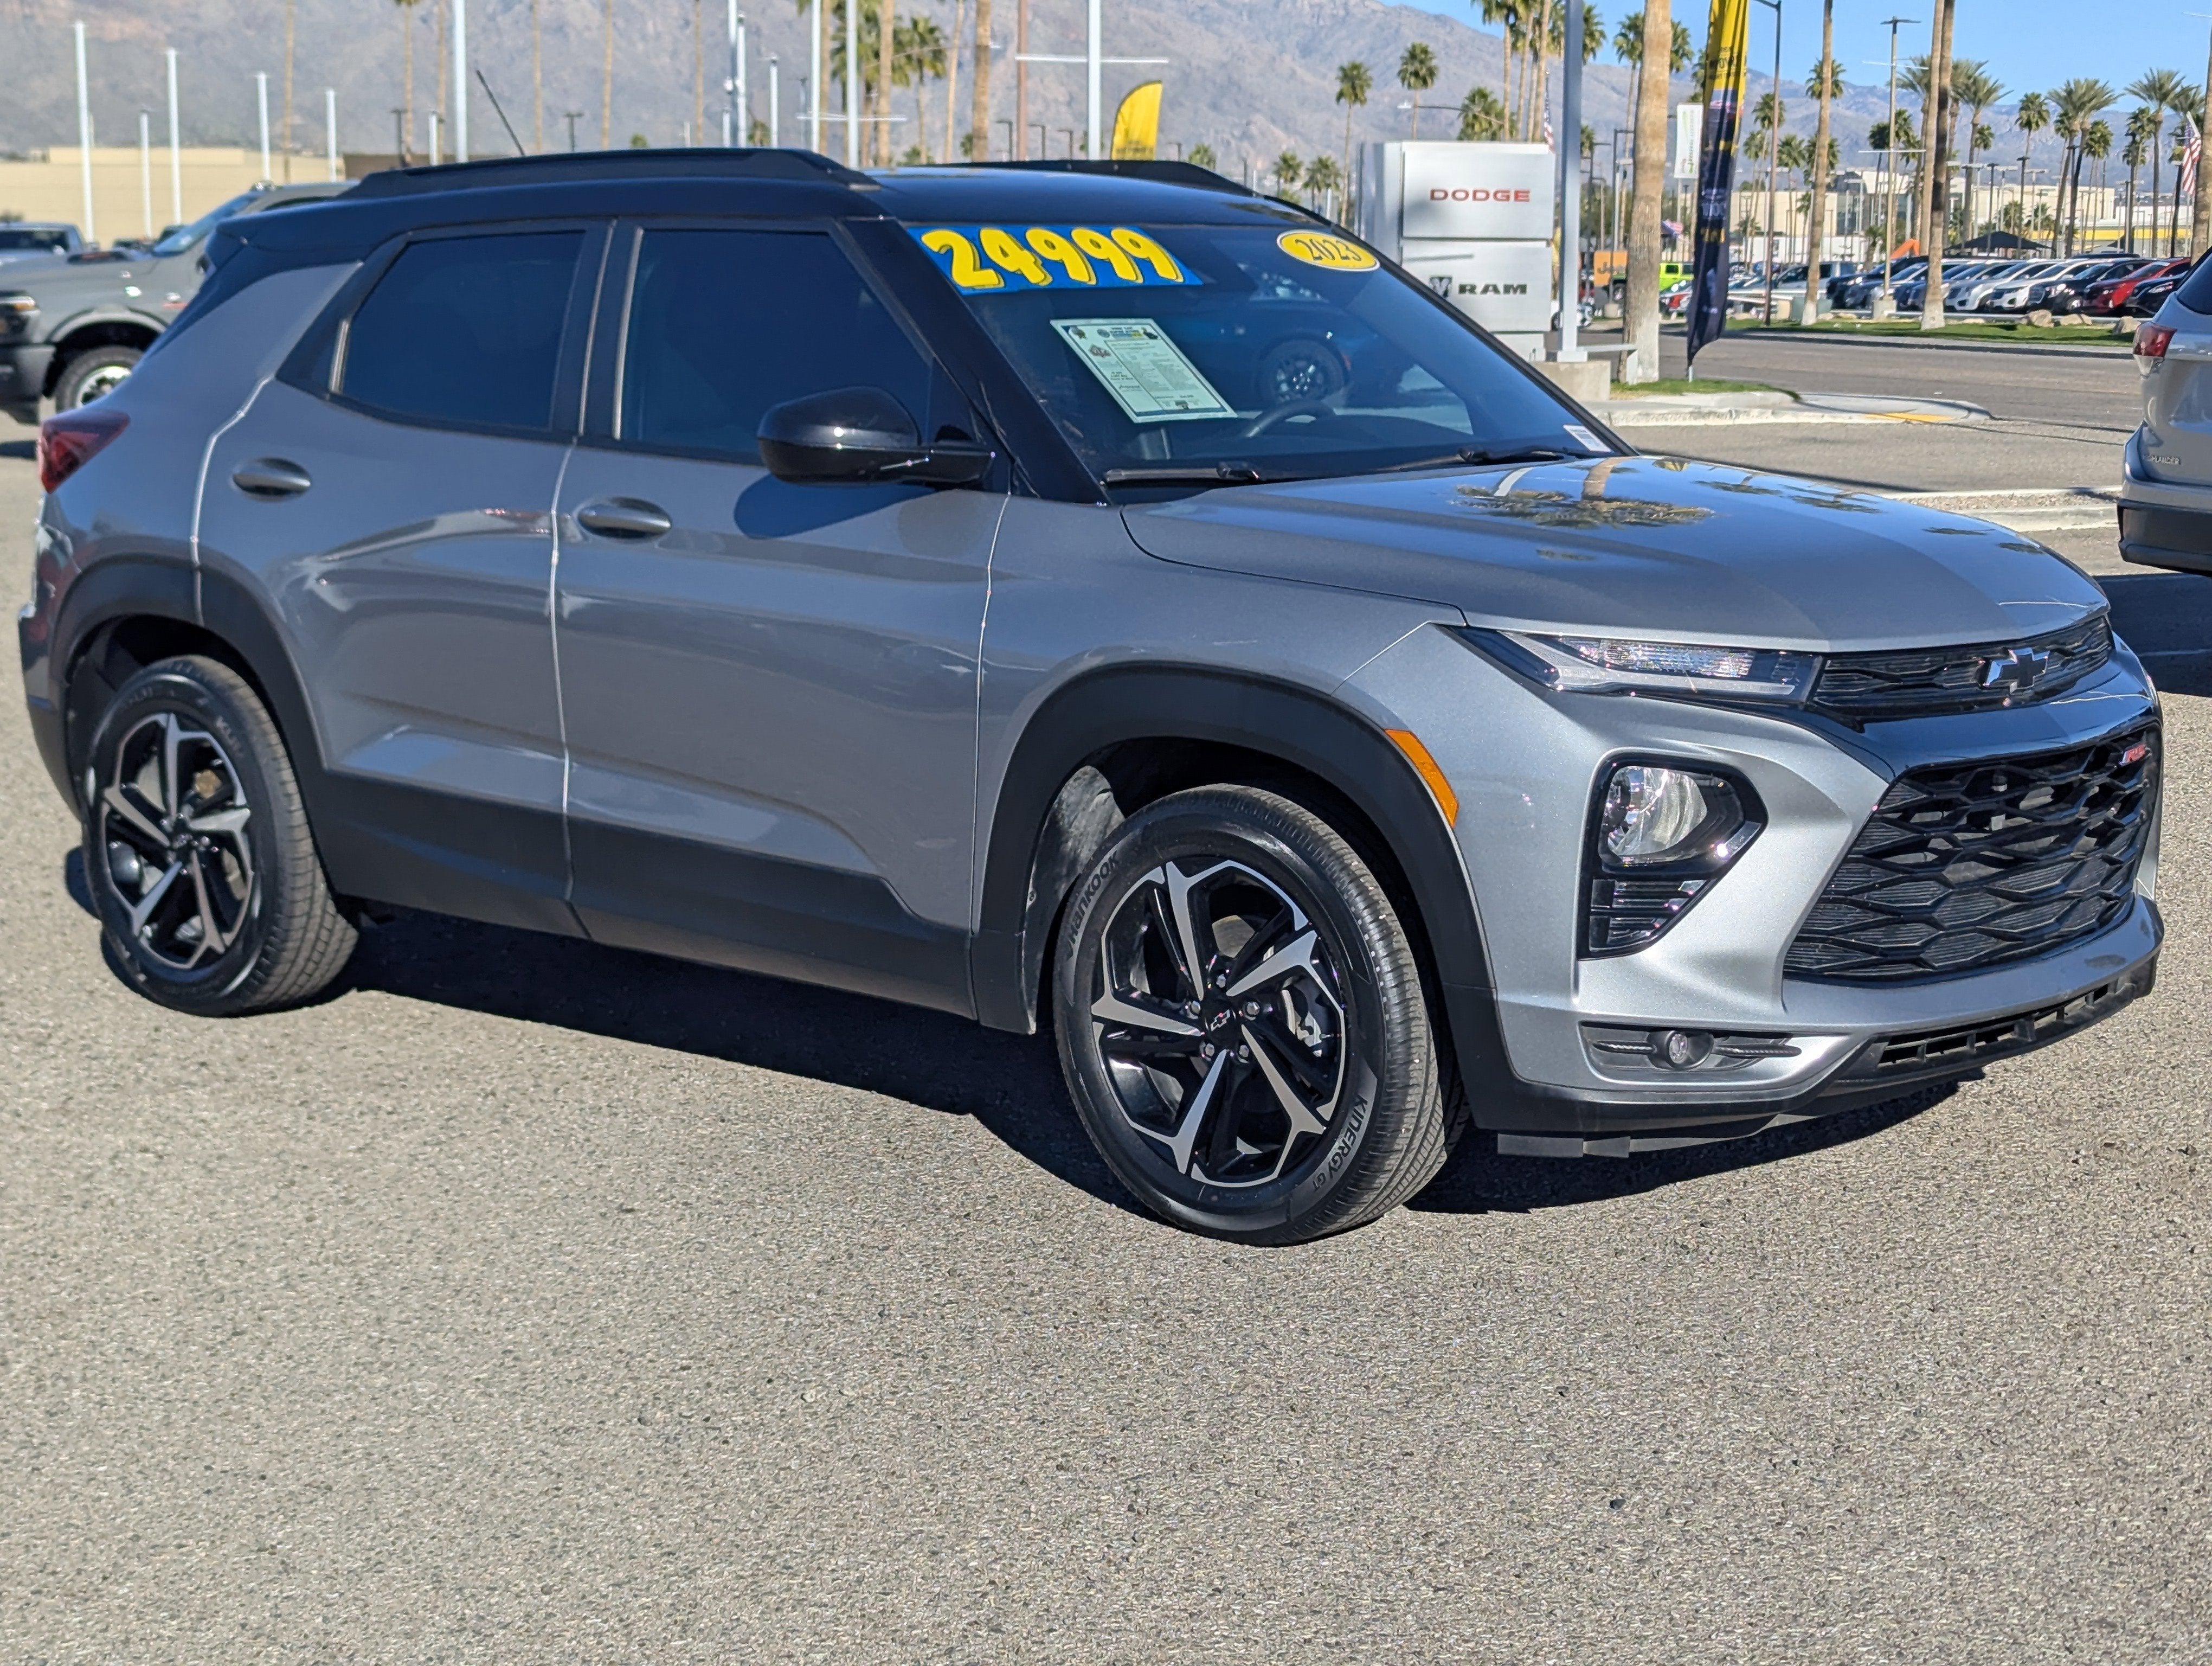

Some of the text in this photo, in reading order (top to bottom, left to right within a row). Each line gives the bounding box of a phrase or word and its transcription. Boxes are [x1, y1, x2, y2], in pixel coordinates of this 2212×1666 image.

[1429, 188, 1531, 202] DODGE
[921, 227, 1184, 288] 24999
[1294, 238, 1362, 262] 2023
[1458, 283, 1527, 295] RAM
[1312, 1093, 1368, 1193] KINERGY GT
